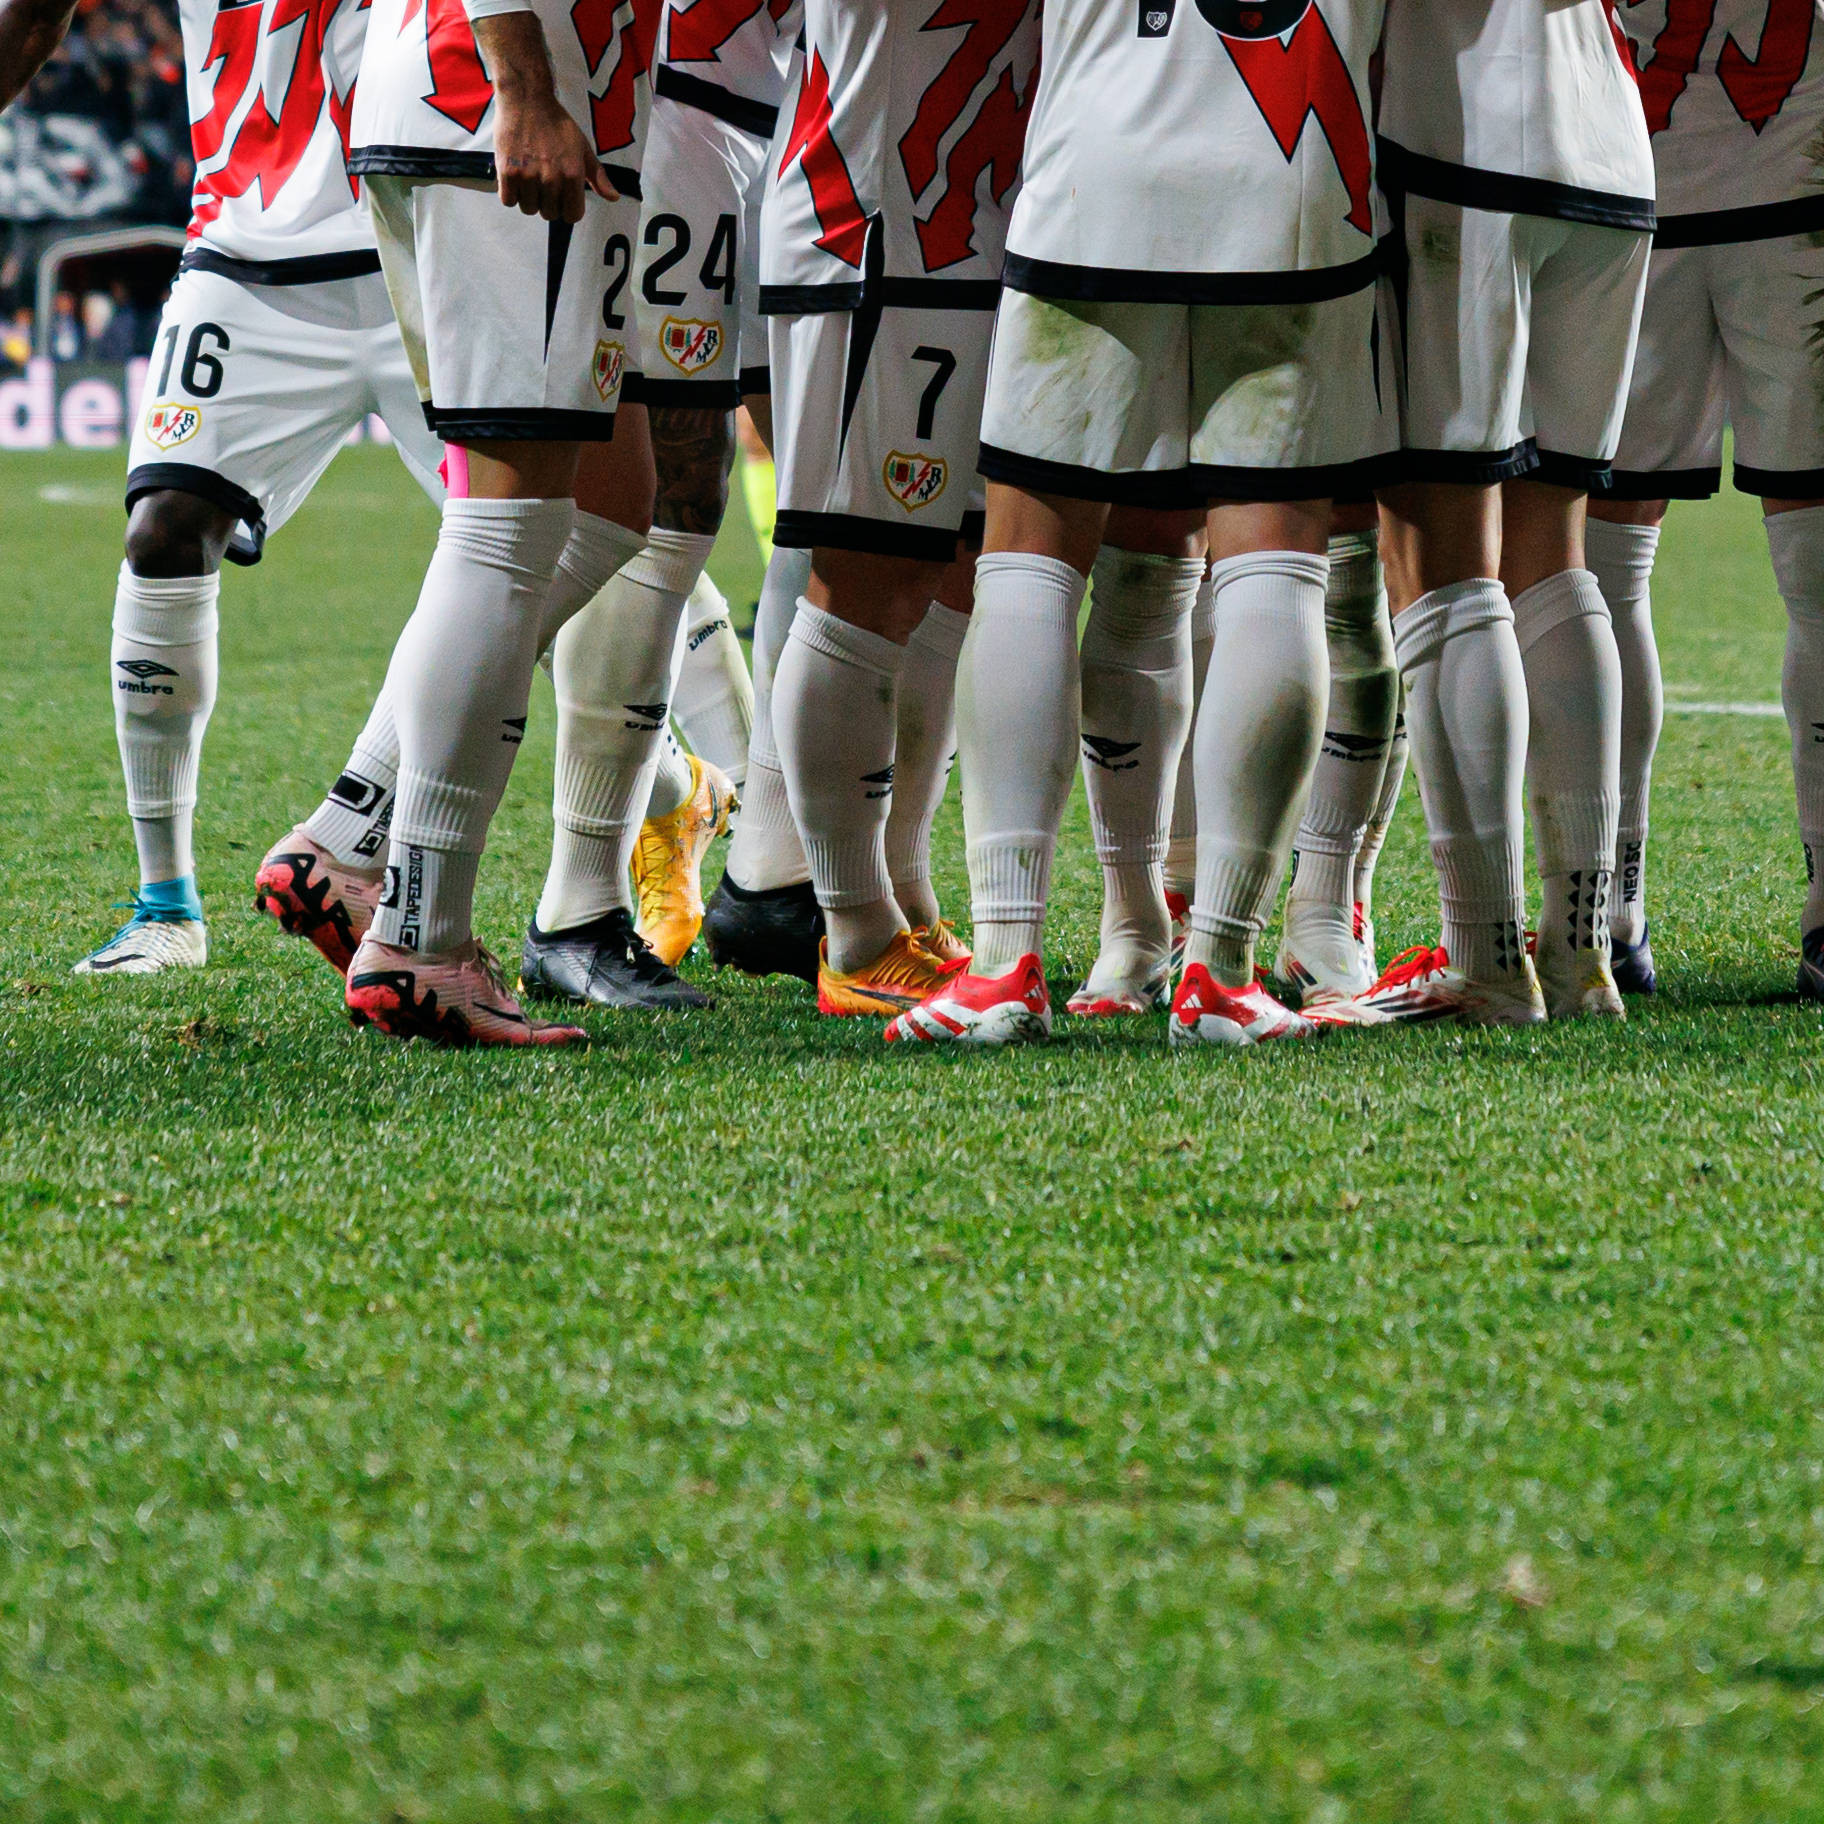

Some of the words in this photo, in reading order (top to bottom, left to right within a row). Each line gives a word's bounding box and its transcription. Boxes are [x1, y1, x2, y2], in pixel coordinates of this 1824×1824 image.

[642, 213, 737, 306] 24
[156, 322, 231, 398] 16
[911, 345, 957, 440] 7
[688, 619, 728, 652] umbro
[118, 680, 174, 695] umbro
